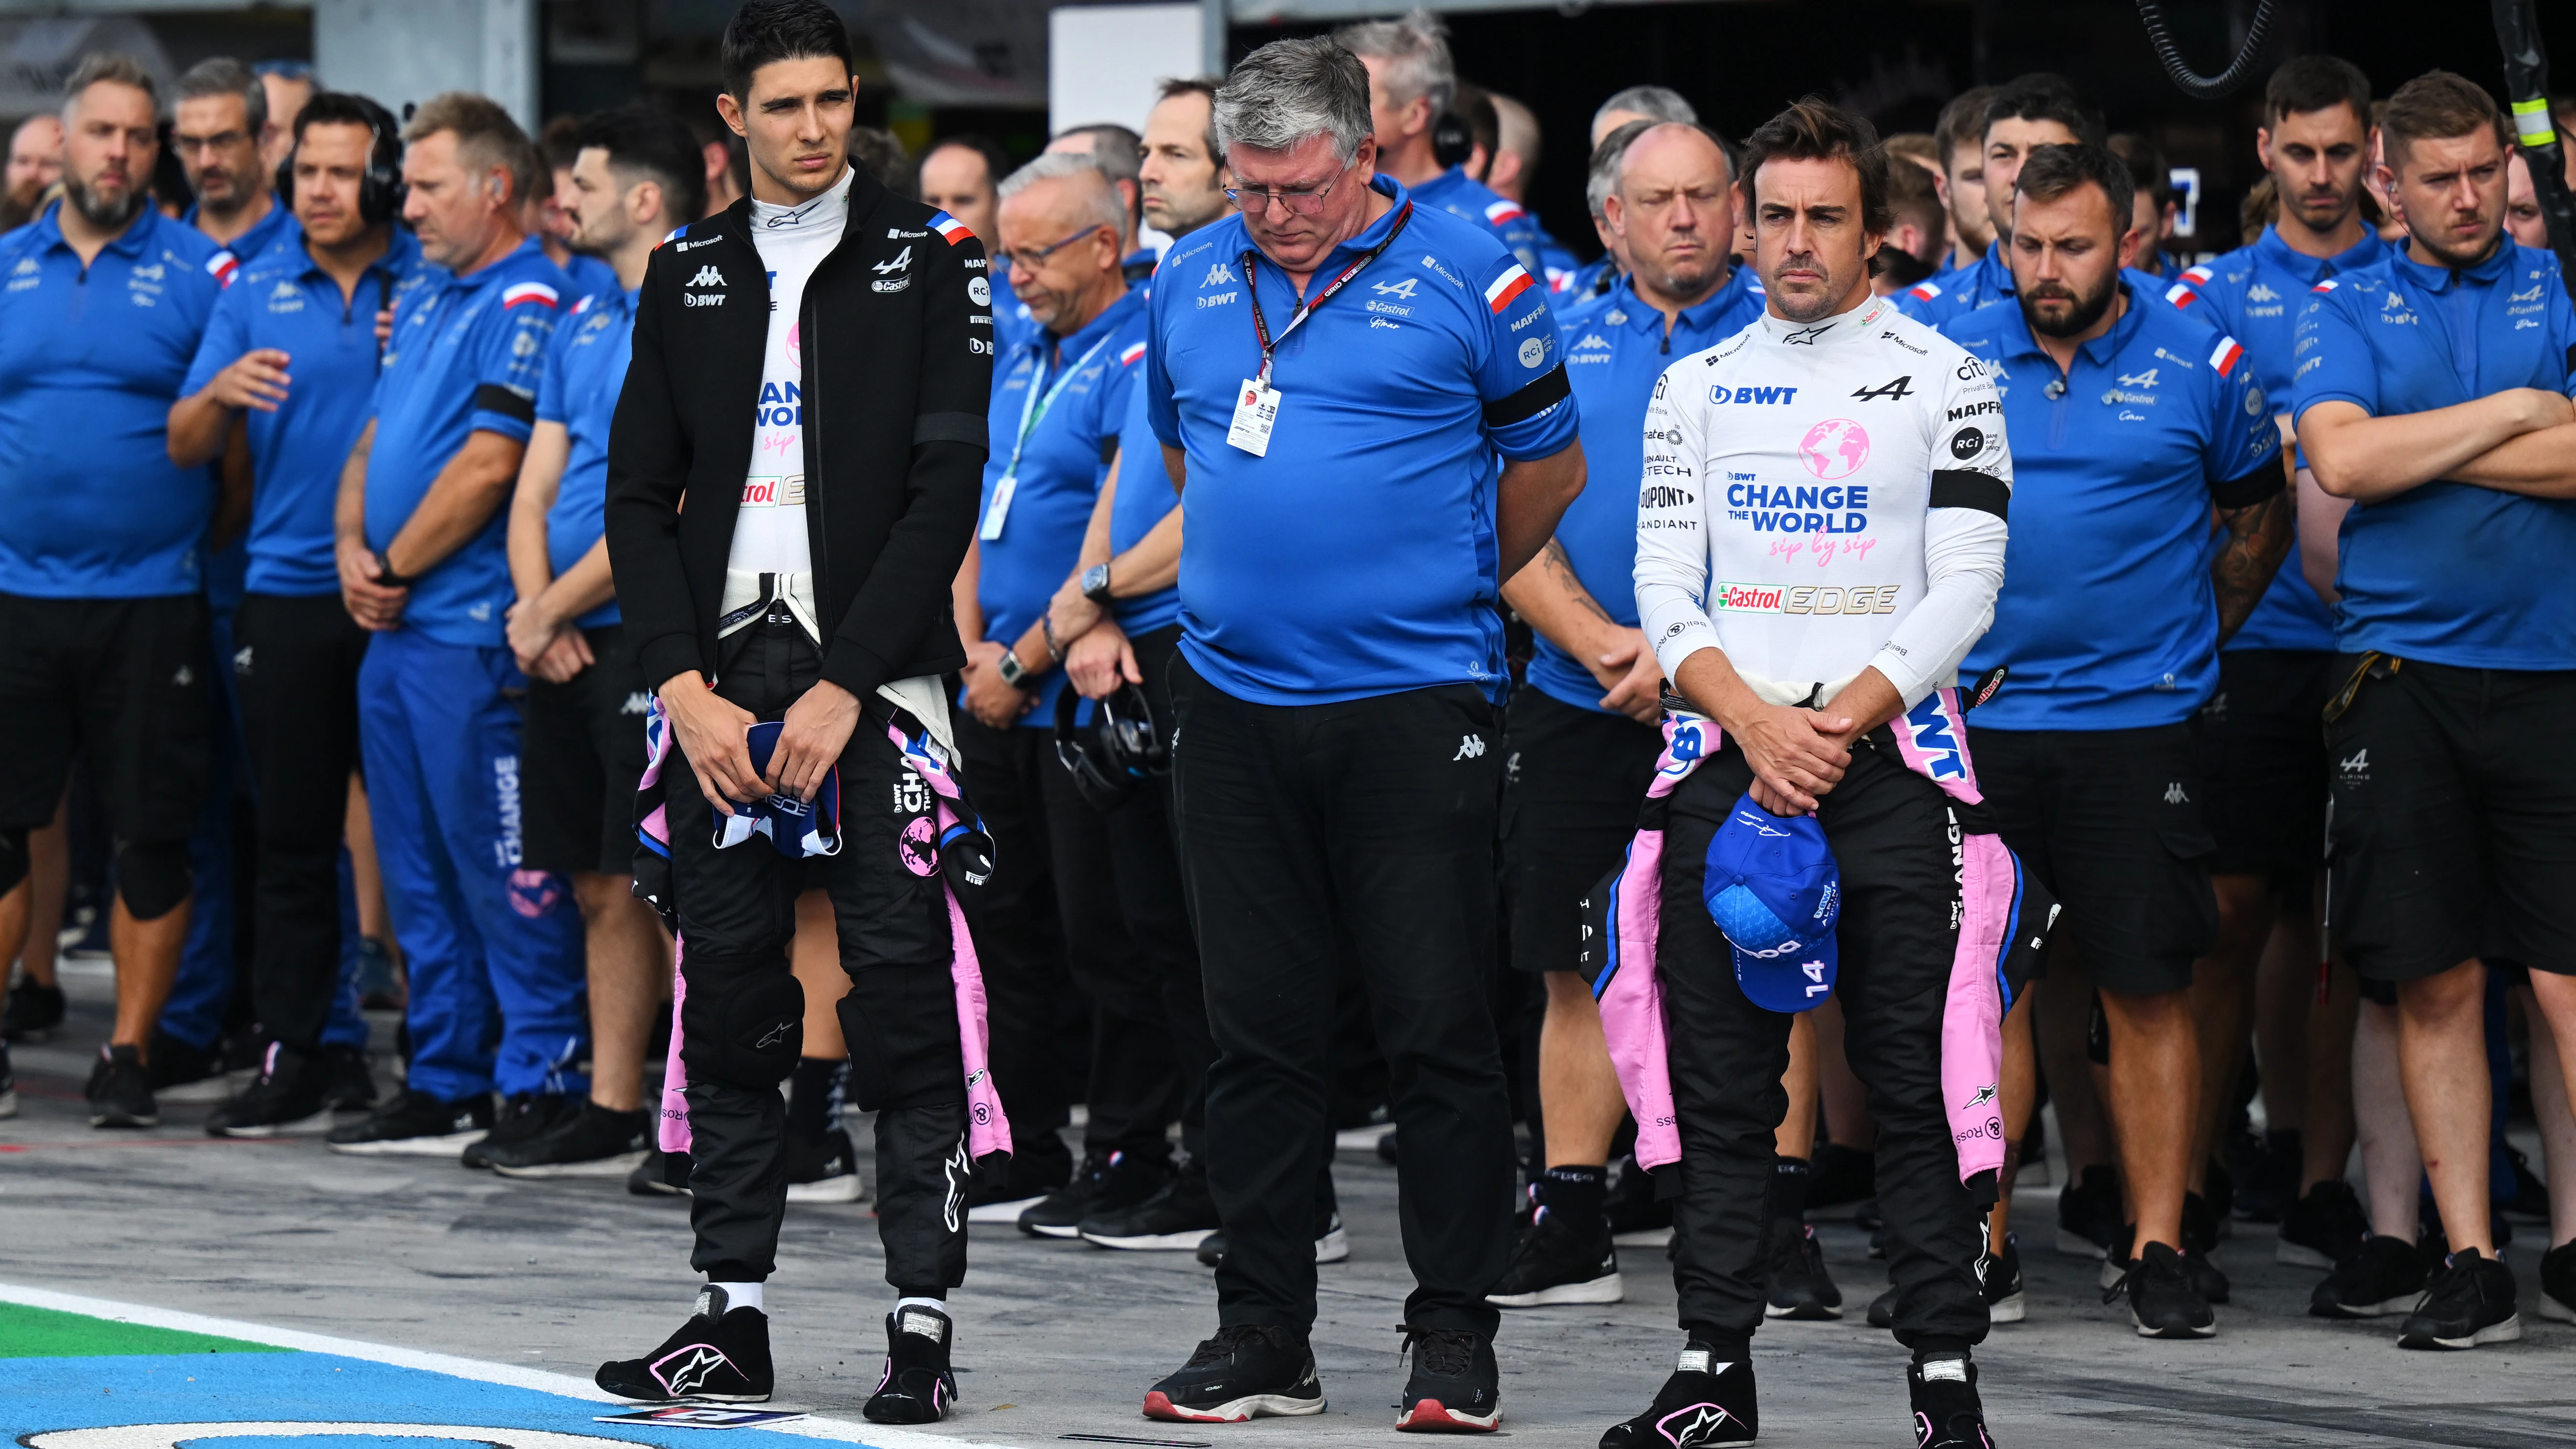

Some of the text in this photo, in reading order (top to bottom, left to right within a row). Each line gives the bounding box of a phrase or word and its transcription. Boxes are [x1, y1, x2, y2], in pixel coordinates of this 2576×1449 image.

[690, 235, 723, 249] Microsoft
[1182, 242, 1212, 260] Microsoft
[965, 259, 986, 268] MAP
[883, 276, 909, 292] Castrol
[1325, 281, 1342, 297] GRID
[1345, 271, 1354, 280] PIT
[1355, 256, 1373, 271] 2022
[1434, 263, 1465, 290] Microsoft
[697, 294, 726, 306] BWT
[1208, 292, 1237, 307] BWT
[1375, 303, 1410, 316] Castrol
[1510, 301, 1546, 332] MAPFRE
[1523, 344, 1541, 360] RCi
[1720, 333, 1752, 359] Microsoft
[1894, 336, 1928, 356] Microsoft
[1733, 387, 1798, 405] BWT
[1963, 383, 1986, 395] Private
[1656, 407, 1668, 416] Bank
[764, 432, 796, 456] sip
[1956, 436, 1979, 449] RCi
[742, 481, 775, 502] trol
[1727, 484, 1868, 510] CHANGE
[1728, 510, 1867, 534] THE WORLD
[1770, 525, 1877, 567] sip by sip
[1728, 585, 1901, 615] Castrol EDGE
[1890, 644, 1908, 656] Bell
[1906, 690, 1968, 783] WT
[1818, 885, 1832, 910] BWT
[1822, 881, 1836, 927] ALPINE
[1802, 960, 1829, 997] 14
[1956, 1125, 1983, 1144] Ross
